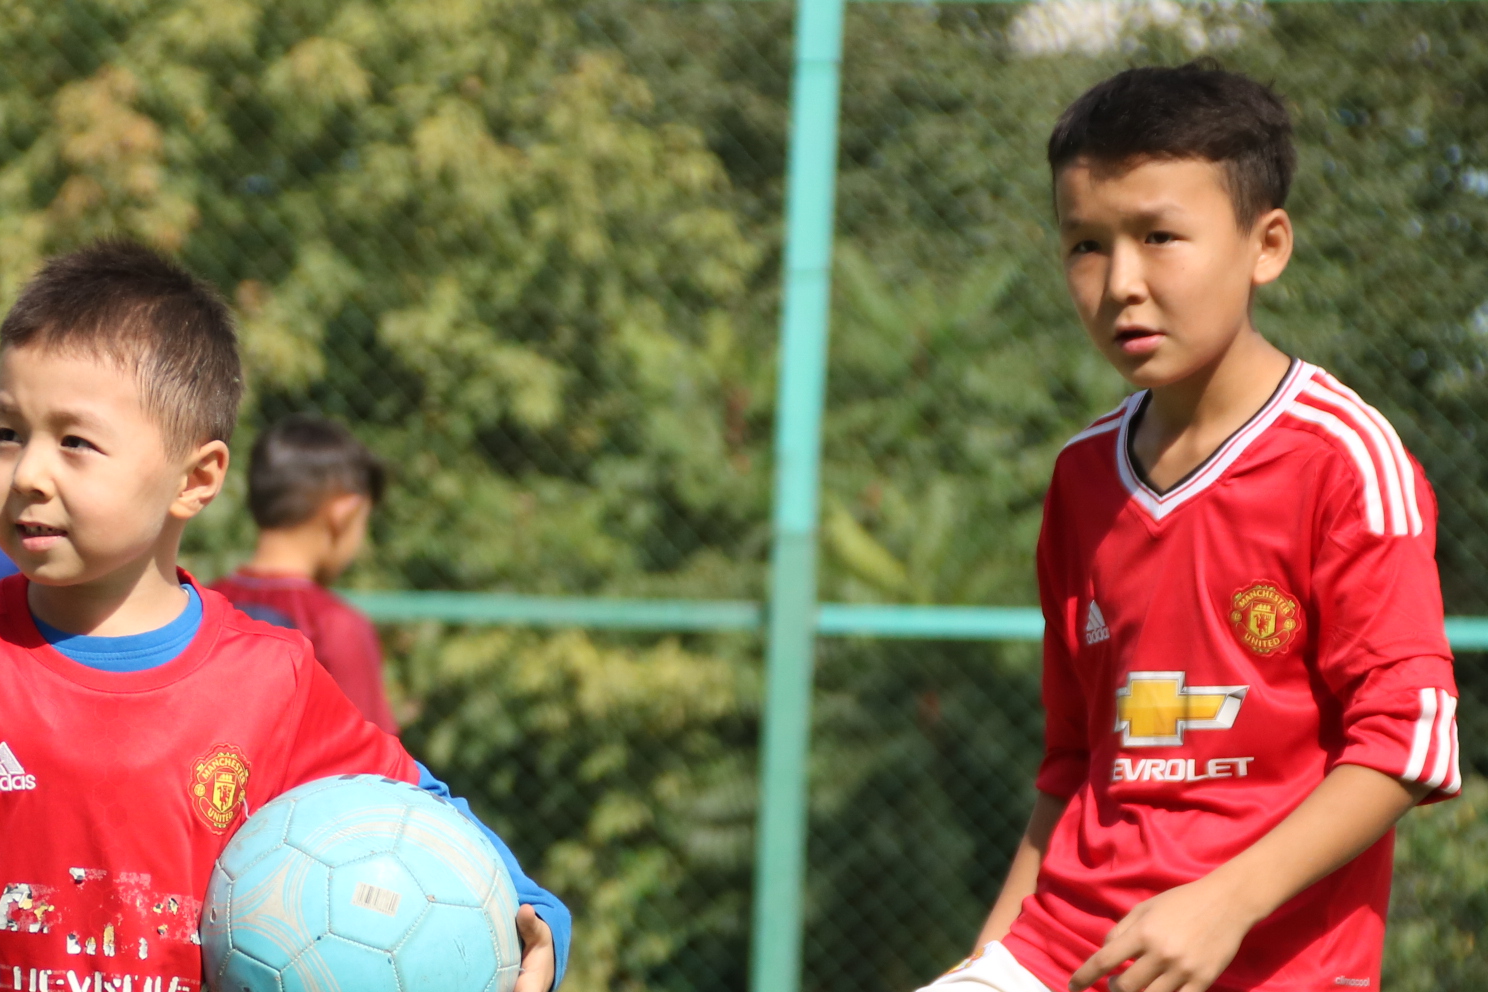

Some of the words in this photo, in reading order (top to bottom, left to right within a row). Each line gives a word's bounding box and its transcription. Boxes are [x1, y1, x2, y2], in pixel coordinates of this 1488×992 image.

[1239, 589, 1291, 615] MANCHESTER
[1244, 633, 1281, 648] UNITED
[202, 758, 246, 785] MANCHESTER
[1112, 757, 1255, 782] EVROLET
[207, 807, 234, 822] UNITED
